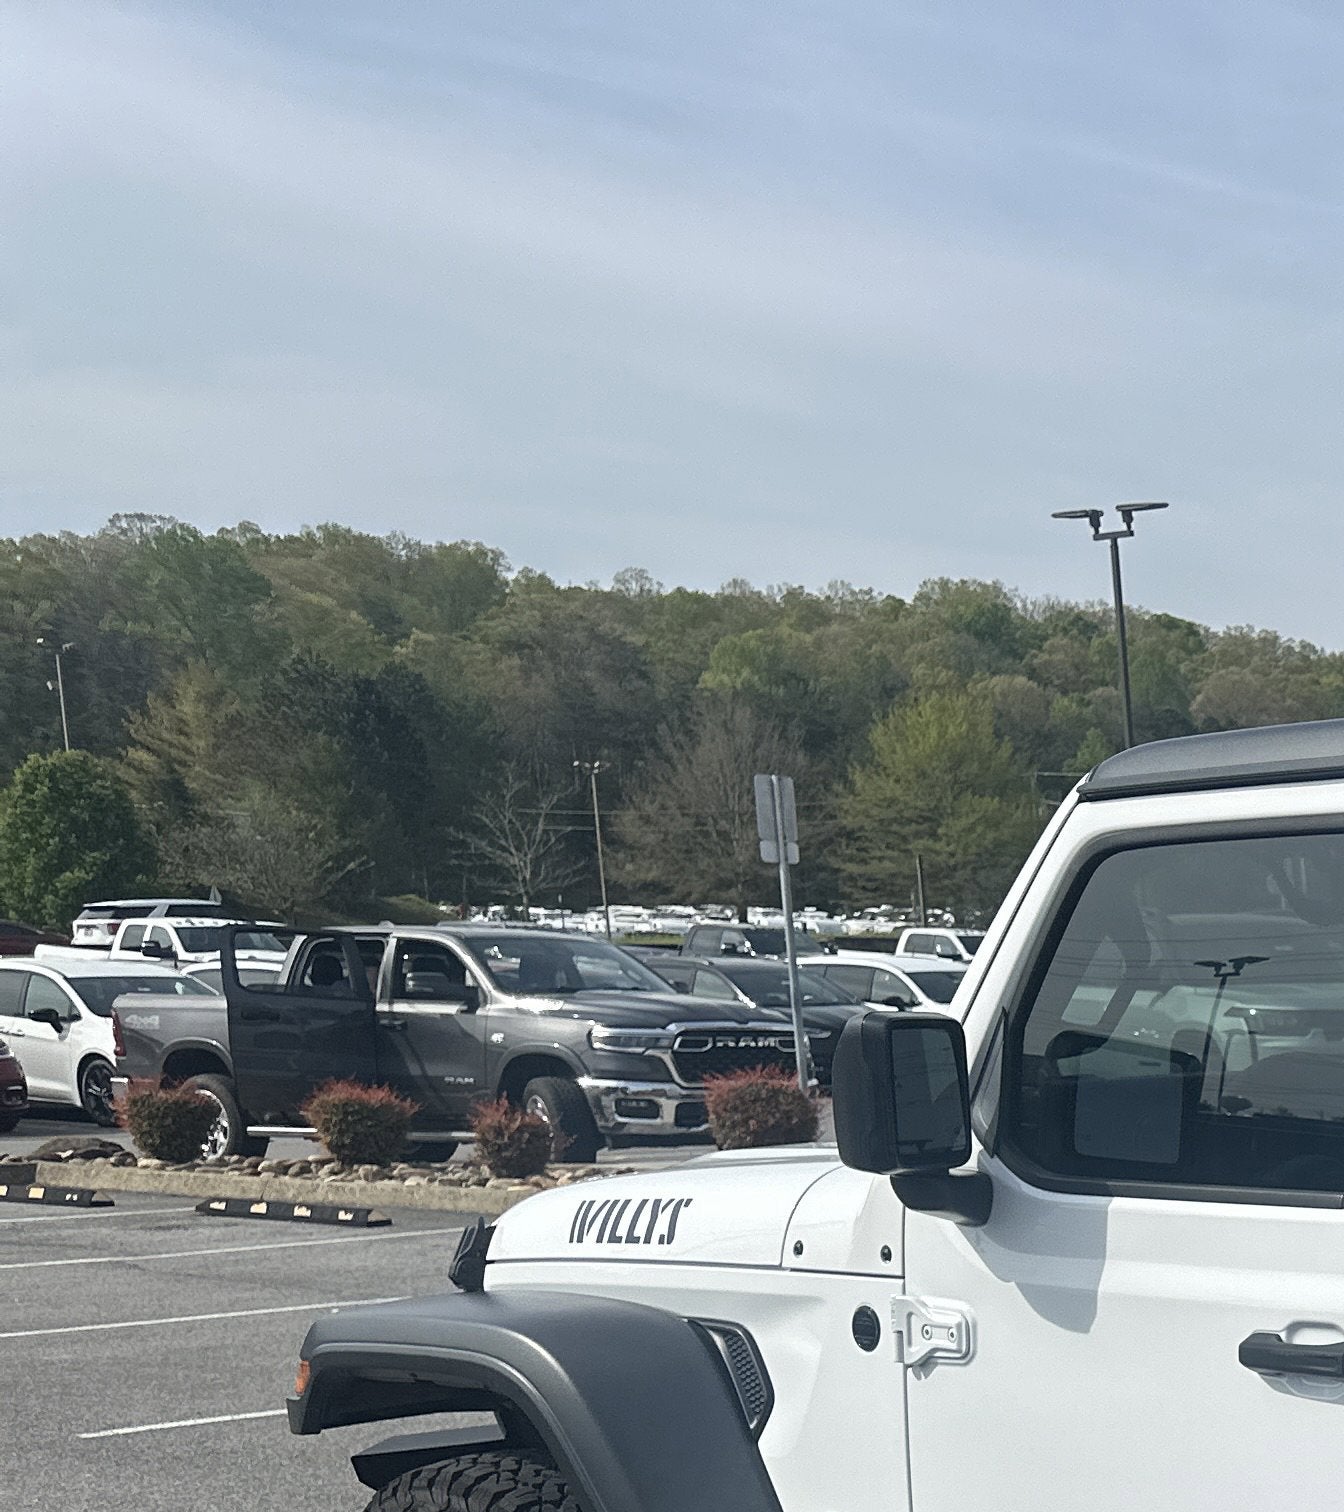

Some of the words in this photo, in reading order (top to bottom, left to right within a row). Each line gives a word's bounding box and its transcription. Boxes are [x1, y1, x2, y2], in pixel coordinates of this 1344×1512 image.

[715, 1036, 778, 1048] RAM
[444, 1076, 474, 1085] RAM
[568, 1198, 694, 1246] WILLYS
